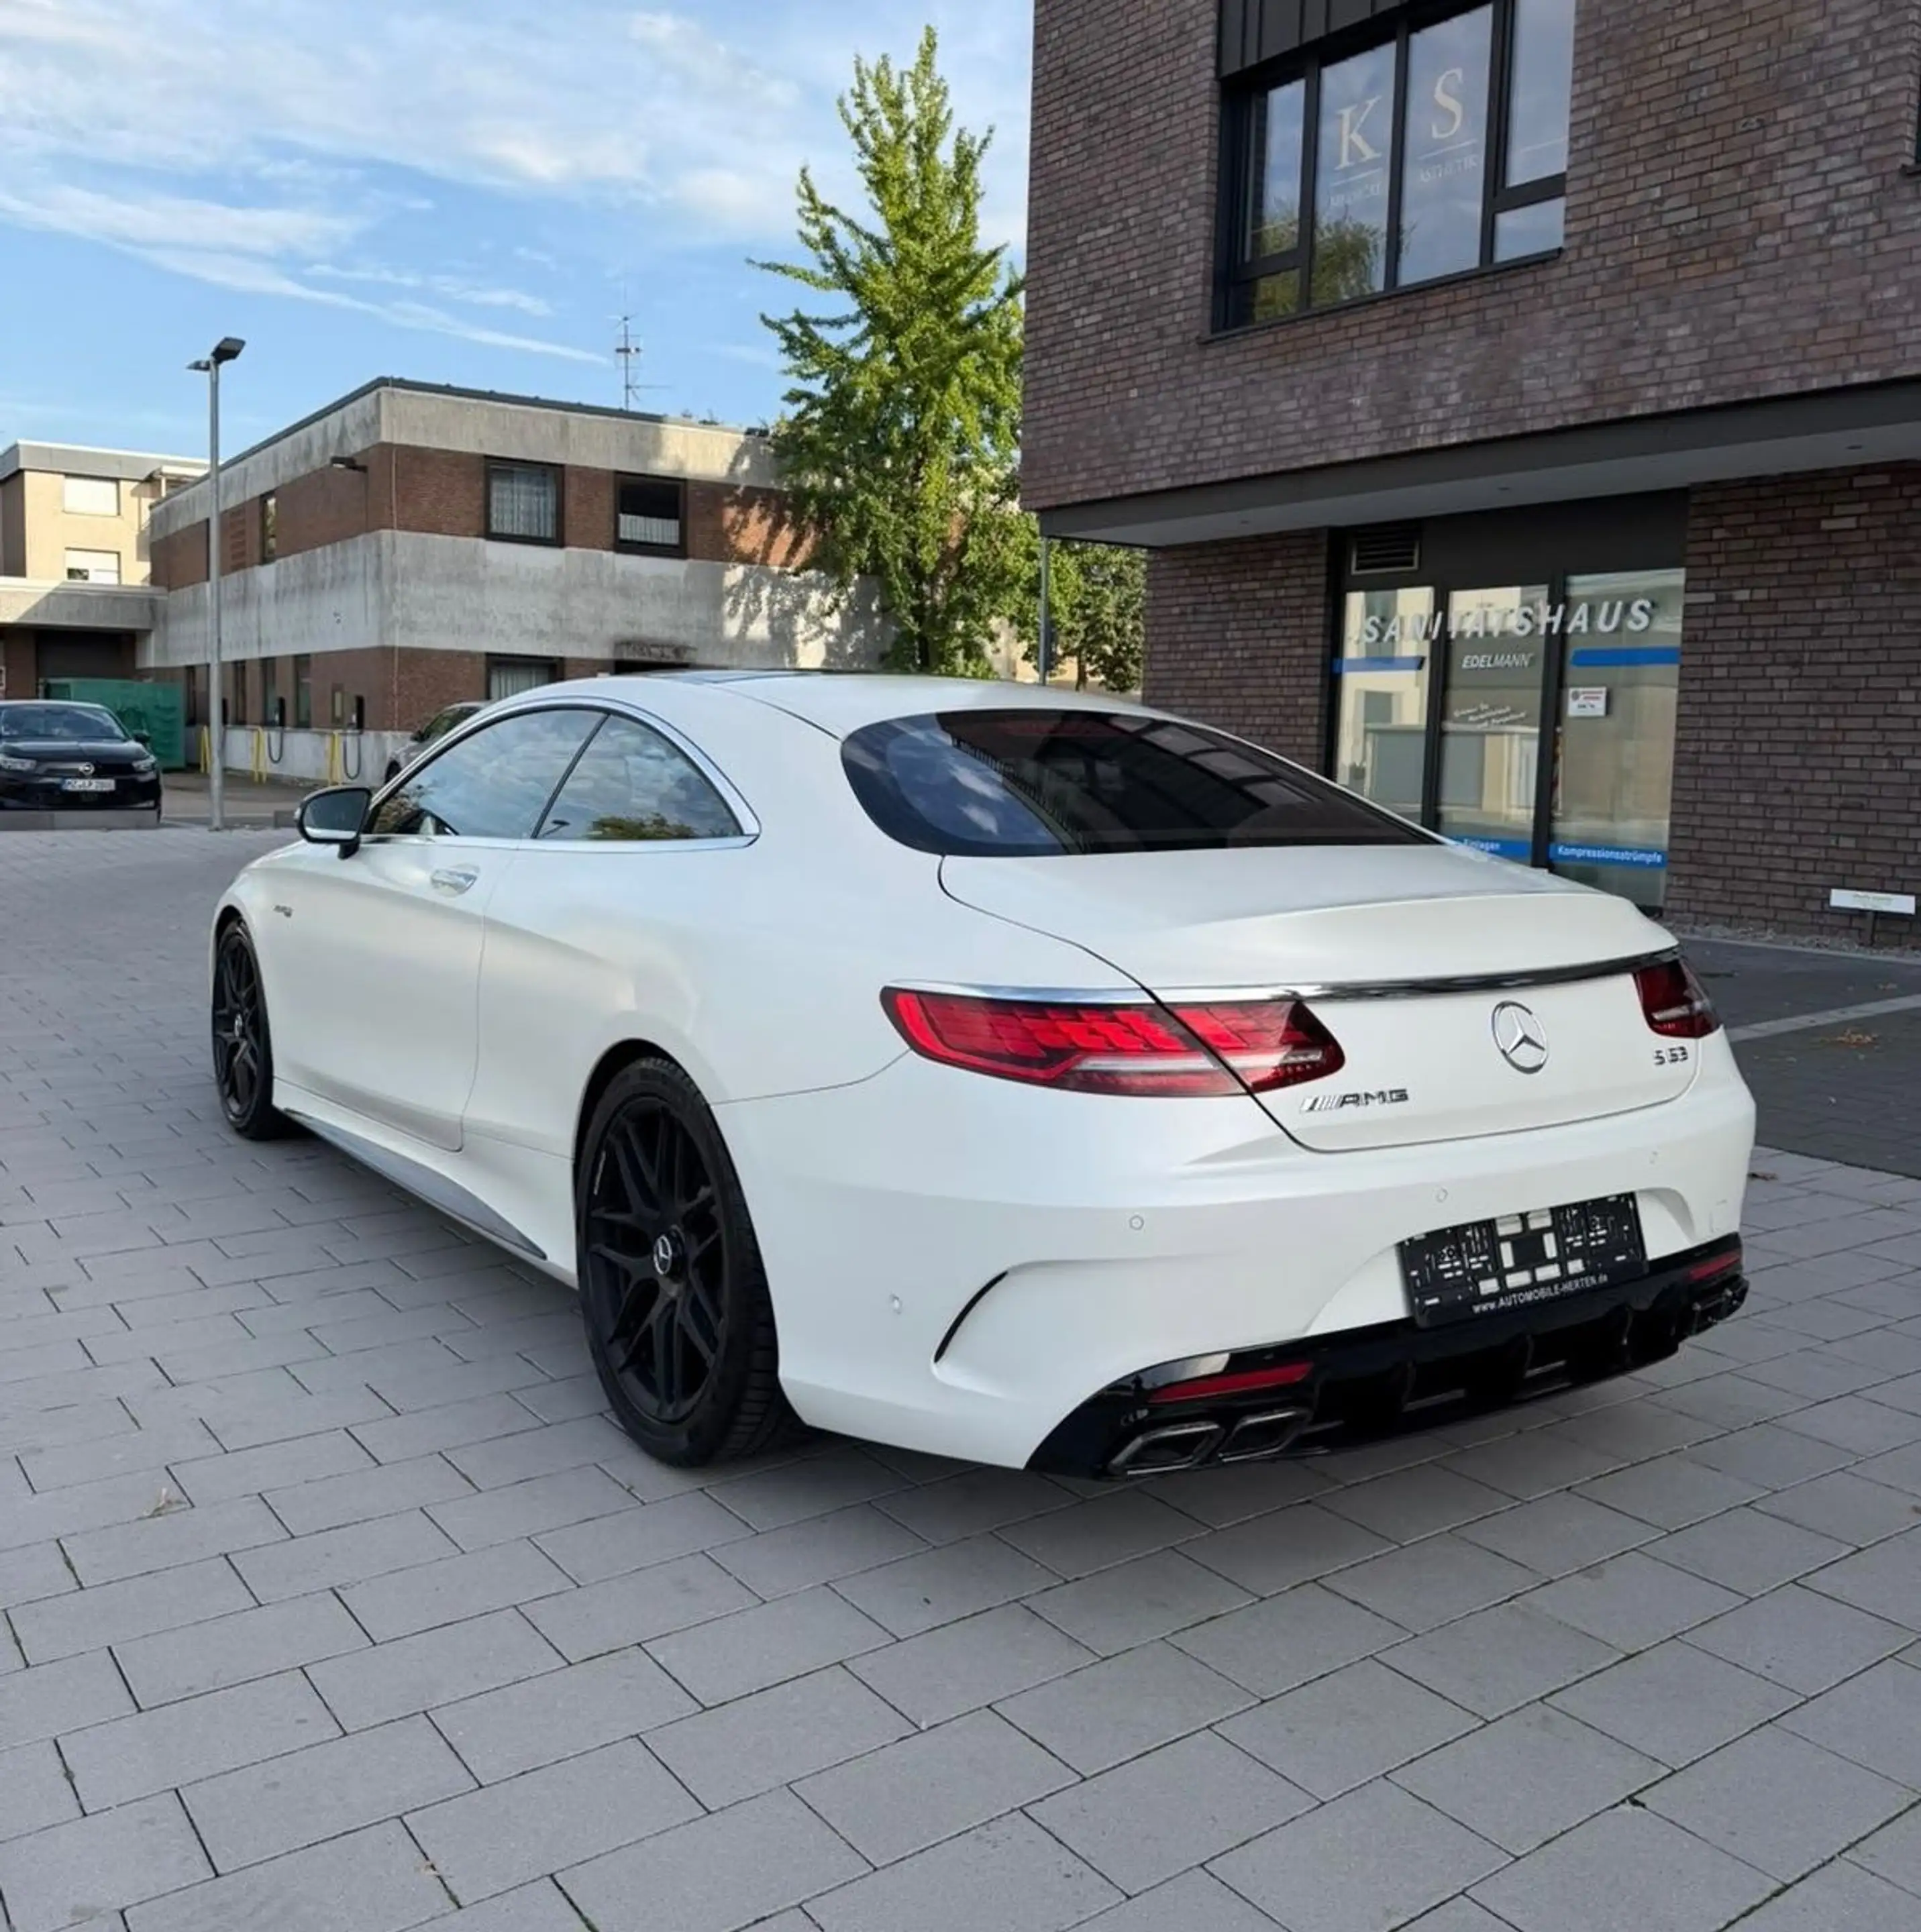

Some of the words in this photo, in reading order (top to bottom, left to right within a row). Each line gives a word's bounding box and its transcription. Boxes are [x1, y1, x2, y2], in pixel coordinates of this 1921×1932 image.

[1335, 95, 1382, 170] K
[1432, 68, 1463, 140] S
[1462, 653, 1533, 669] EDELMANN
[1557, 845, 1663, 865] Kompressionsstrümpfe
[1654, 1050, 1665, 1065] S
[1668, 1046, 1688, 1063] 53
[1339, 1088, 1408, 1108] AMG
